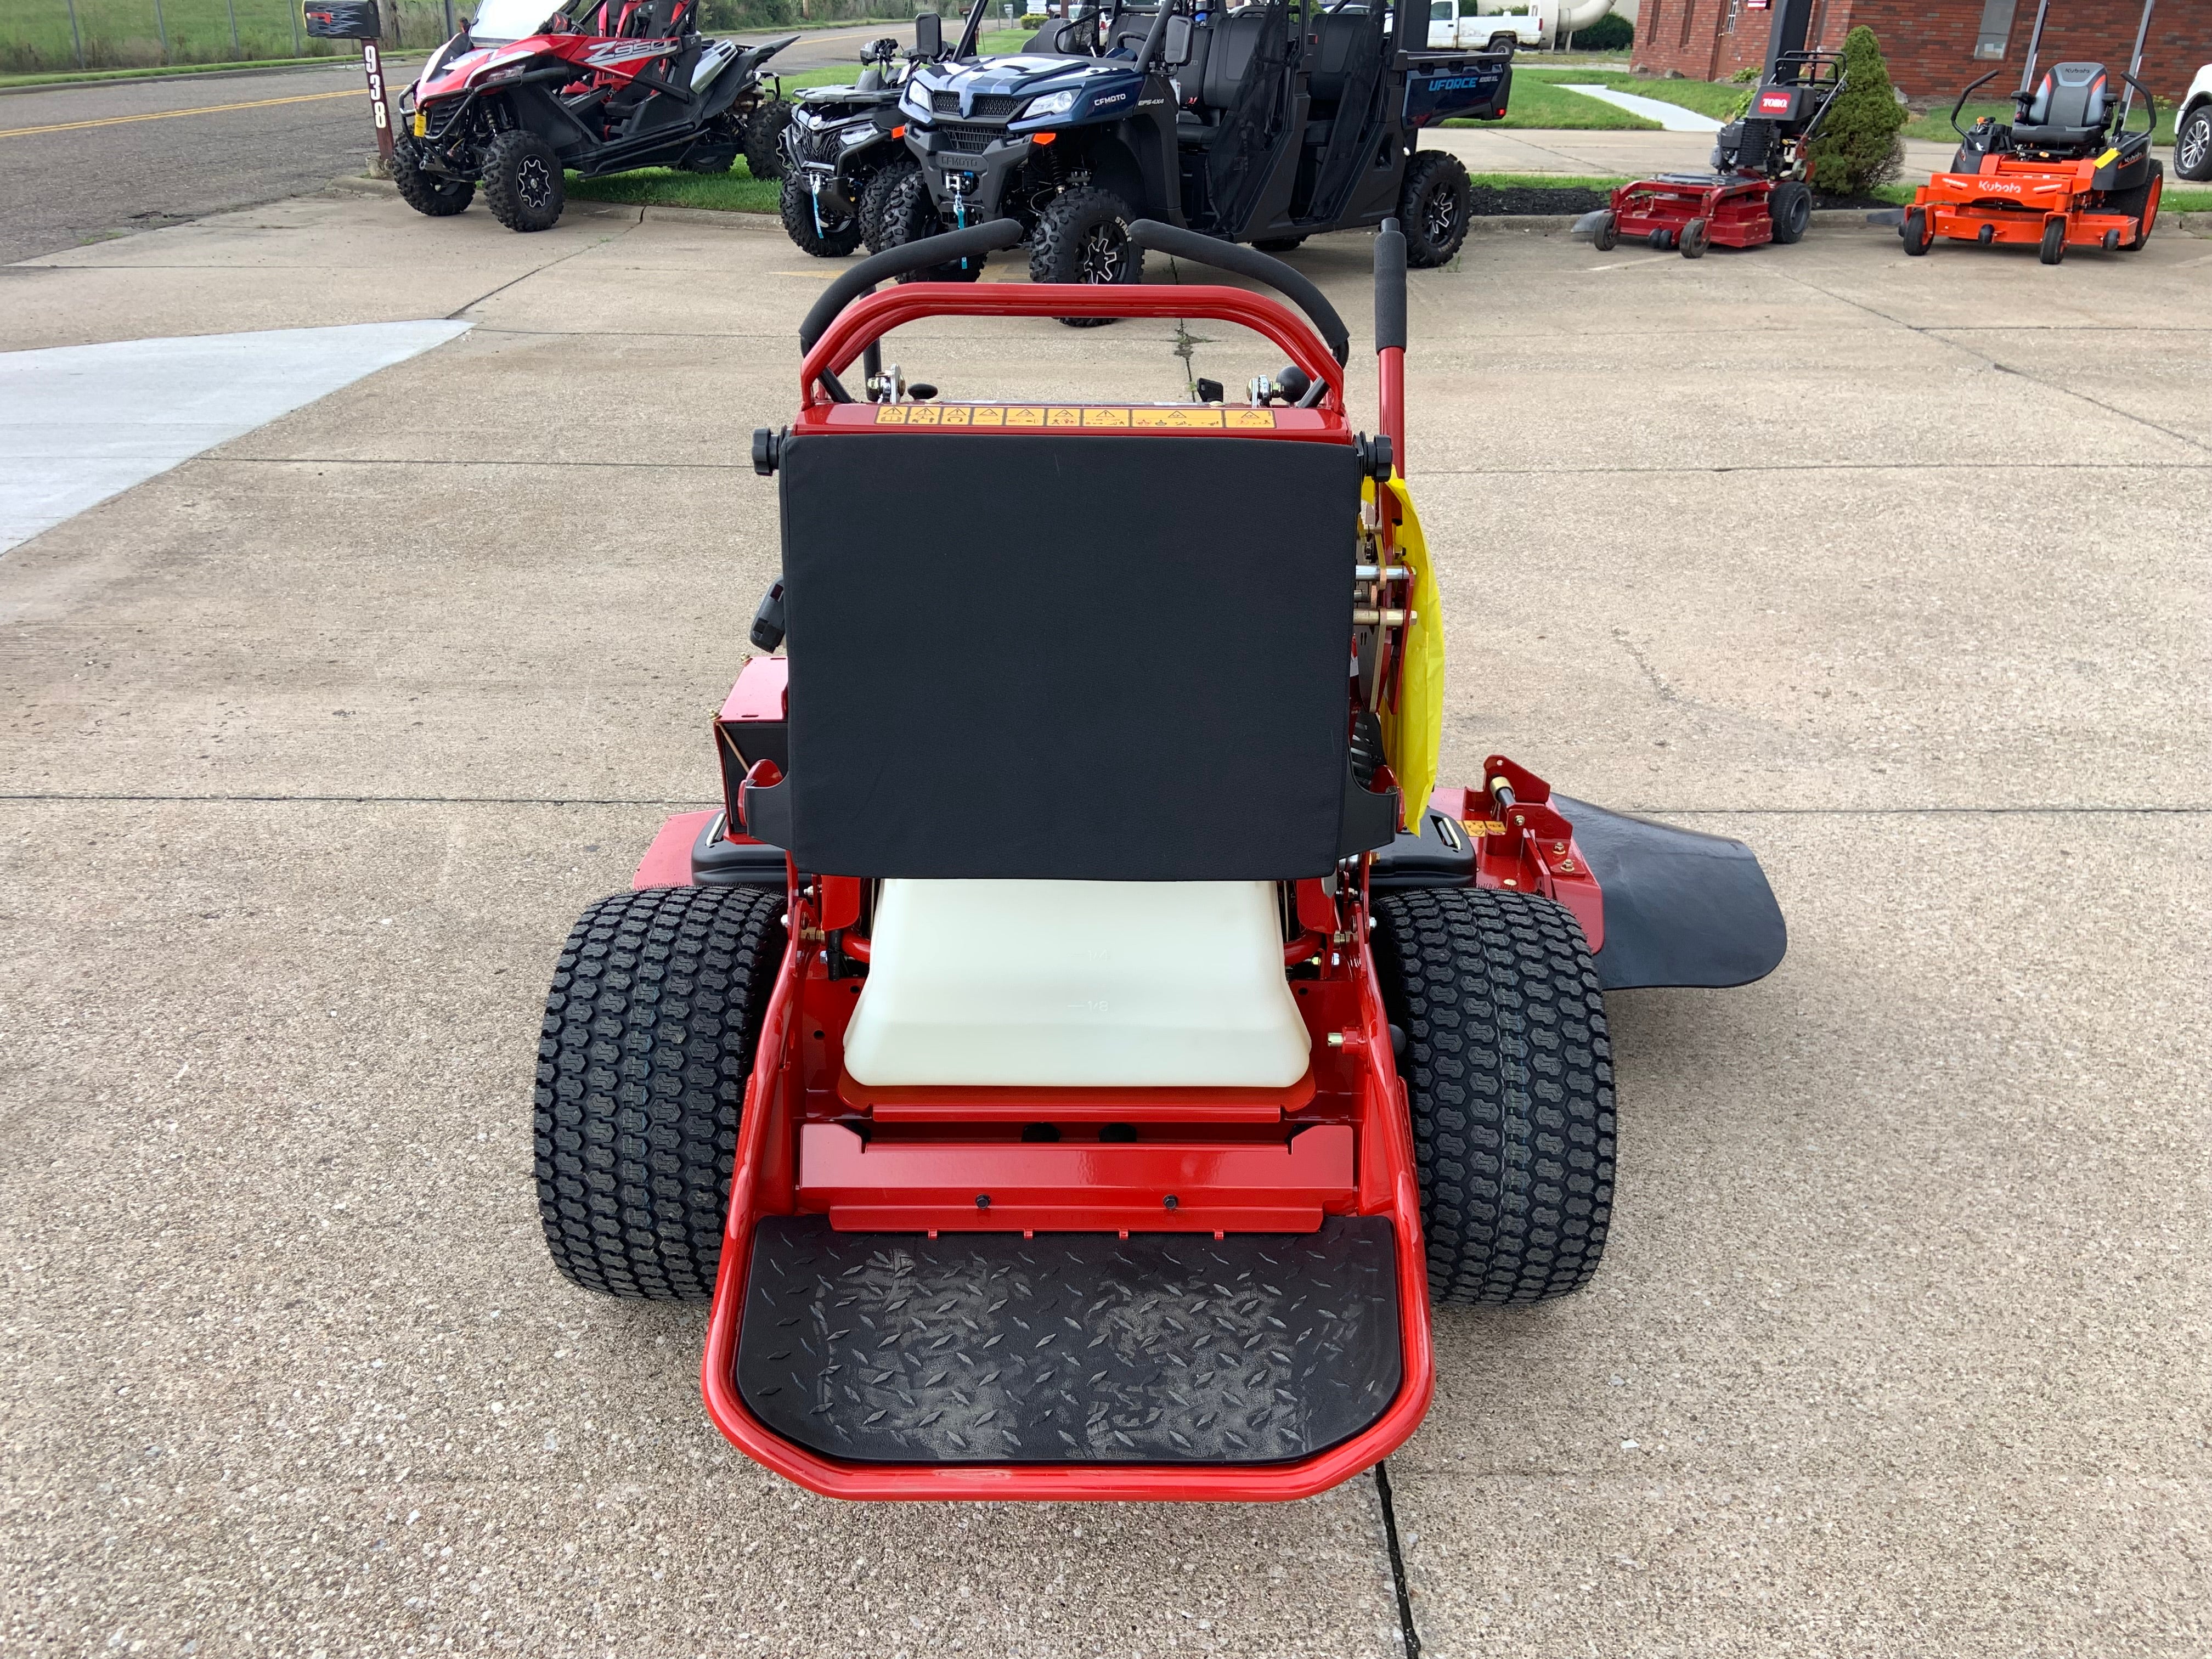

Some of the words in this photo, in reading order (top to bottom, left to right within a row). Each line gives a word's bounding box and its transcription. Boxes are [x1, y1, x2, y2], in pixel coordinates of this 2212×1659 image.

[364, 45, 386, 128] 938
[1429, 77, 1479, 91] UFORCE
[1094, 93, 1126, 106] CFMOTO
[1763, 98, 1787, 108] TORO
[941, 156, 978, 167] CFMOTO
[1978, 180, 2021, 194] Kubota
[1087, 1000, 1109, 1012] 1/8
